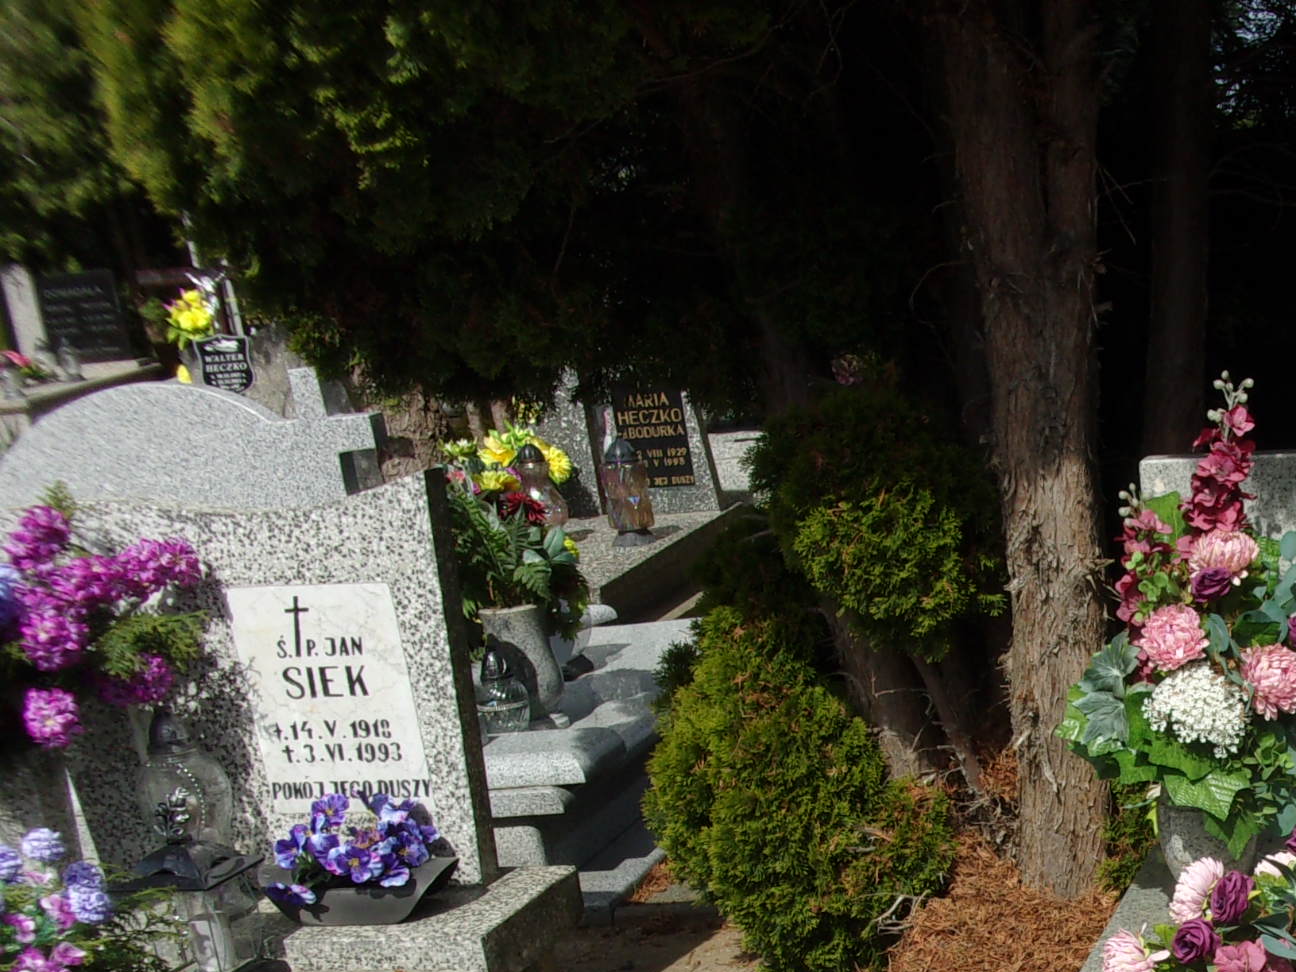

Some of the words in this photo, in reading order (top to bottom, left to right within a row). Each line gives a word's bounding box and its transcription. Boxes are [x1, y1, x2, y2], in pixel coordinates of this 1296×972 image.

[617, 407, 682, 425] HECZKO
[629, 424, 686, 440] BODURKA
[325, 636, 364, 657] JAN
[282, 664, 370, 700] SIEK
[378, 778, 433, 799] DUSZY
